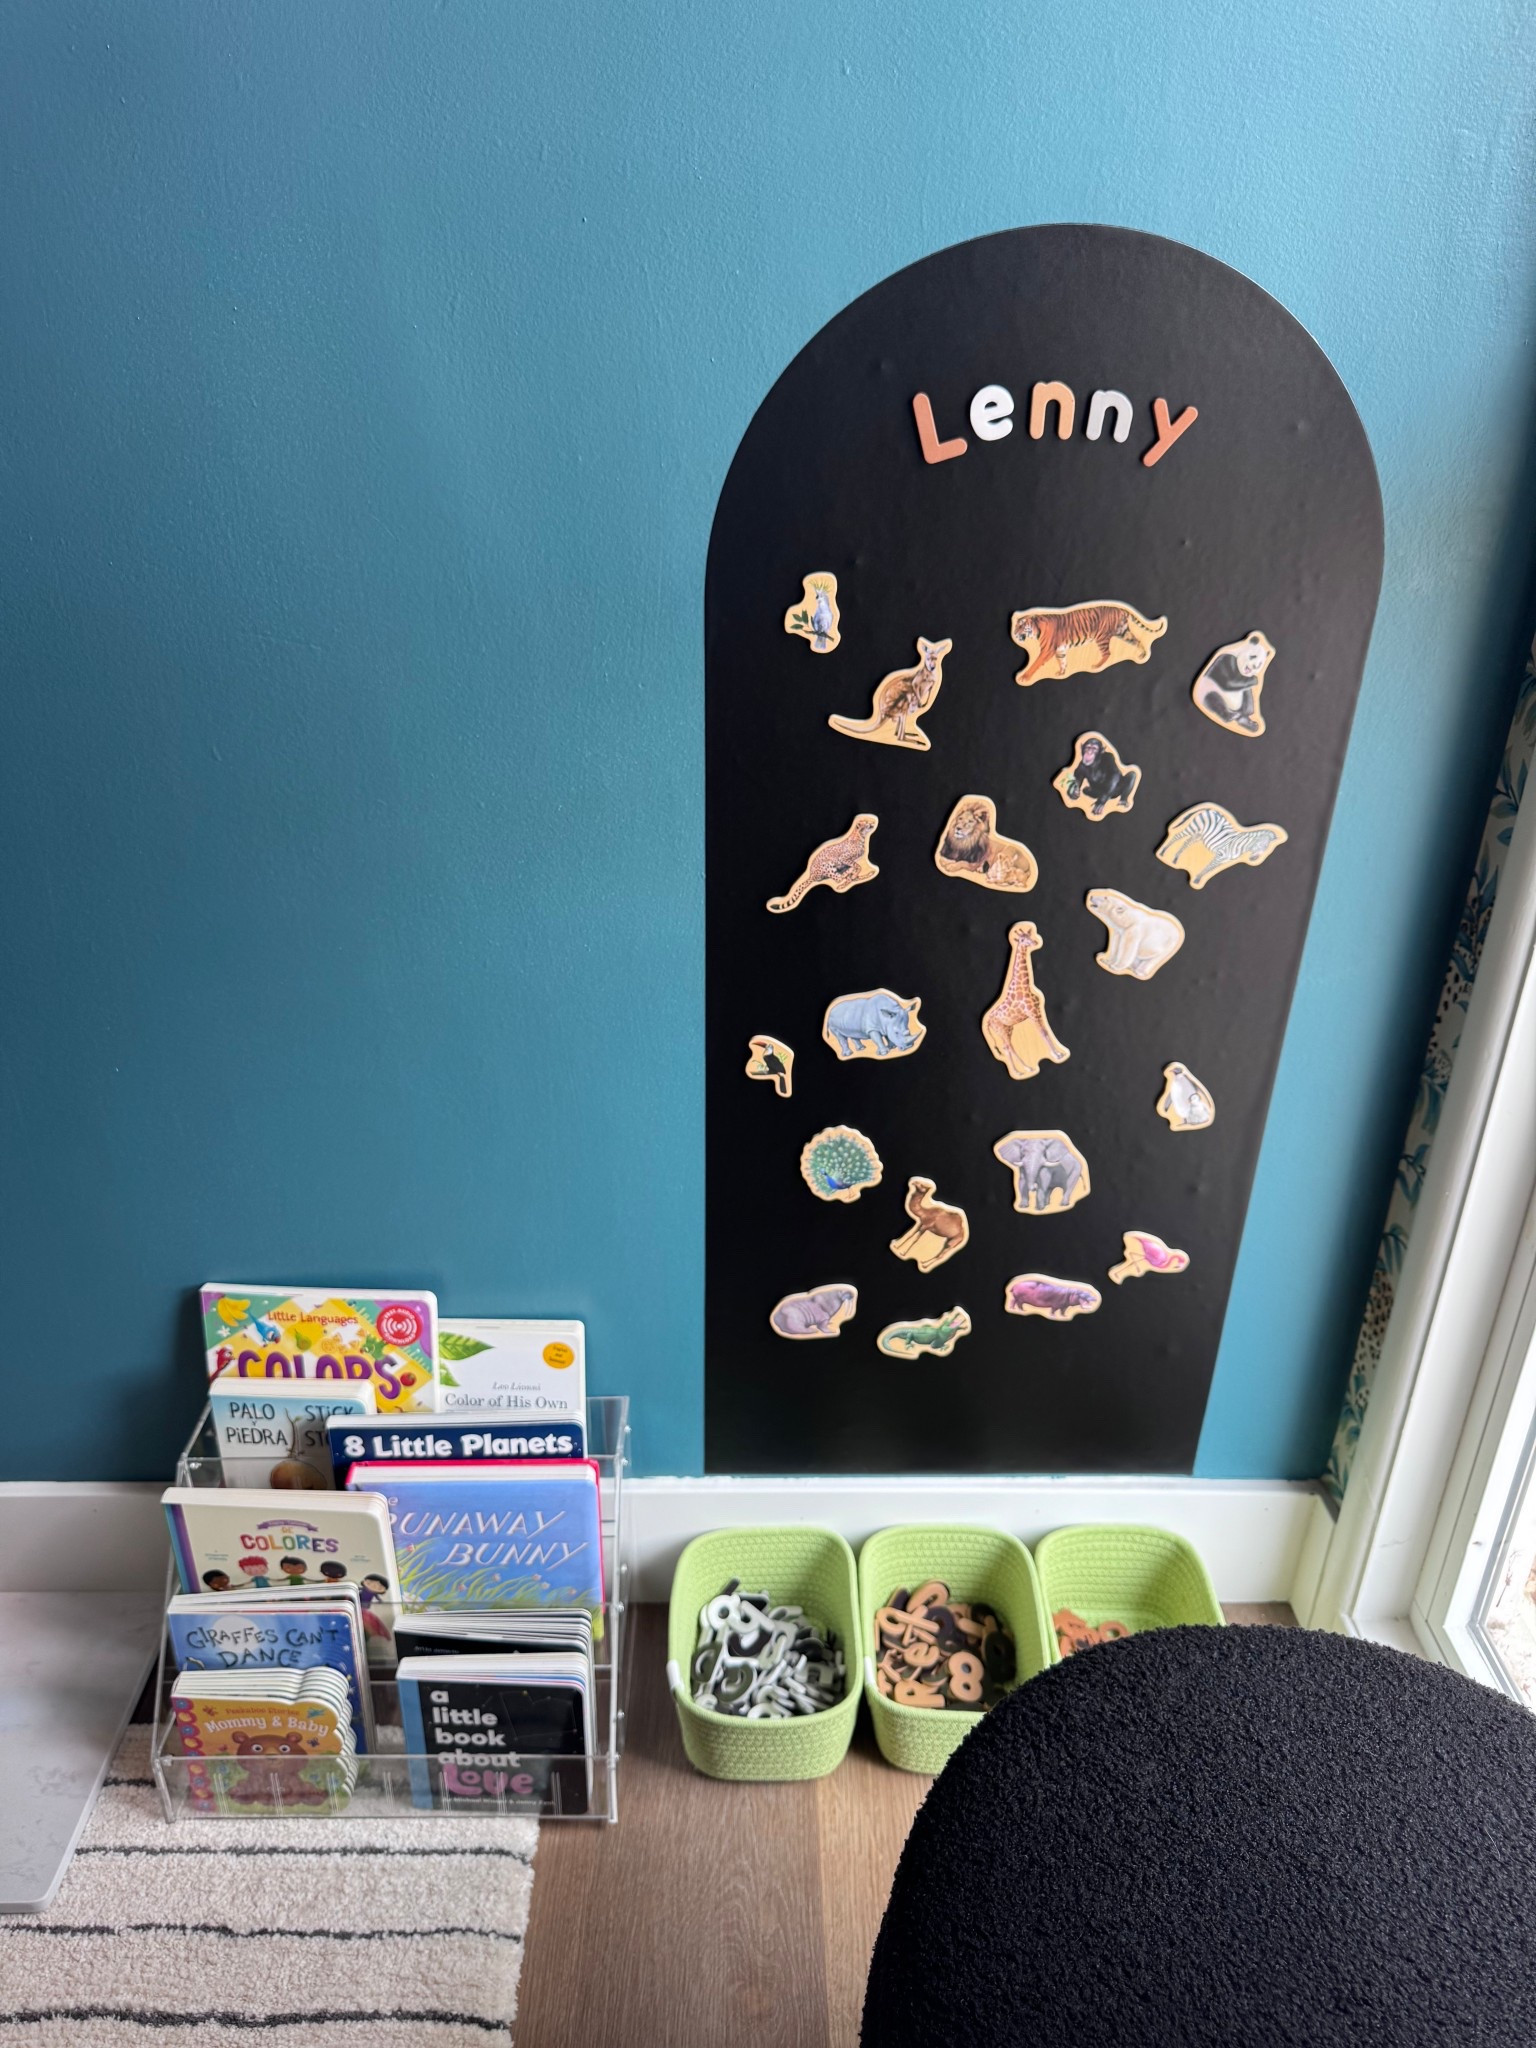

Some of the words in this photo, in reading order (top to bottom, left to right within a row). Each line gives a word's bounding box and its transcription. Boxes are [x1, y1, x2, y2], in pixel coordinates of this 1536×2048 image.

[912, 381, 1198, 467] Lenny
[267, 1311, 297, 1322] Little
[300, 1312, 359, 1326] Languages
[445, 1393, 485, 1407] Color
[488, 1394, 503, 1408] of
[507, 1395, 532, 1408] His
[535, 1396, 568, 1409] Own
[229, 1402, 275, 1420] PALO
[344, 1435, 366, 1458] 8
[373, 1434, 452, 1458] Little
[460, 1433, 573, 1457] Planets
[240, 1534, 339, 1553] COLORES
[437, 1542, 589, 1571] BUNNY
[186, 1627, 279, 1649] GIRAFFES
[286, 1626, 339, 1647] CAN'T
[219, 1649, 302, 1668] DANCE
[430, 1690, 450, 1703] a
[432, 1706, 498, 1726] little
[203, 1716, 267, 1734] Mommy
[272, 1716, 282, 1727] &
[288, 1718, 330, 1737] Baby
[434, 1727, 506, 1746] book
[438, 1748, 521, 1767] about
